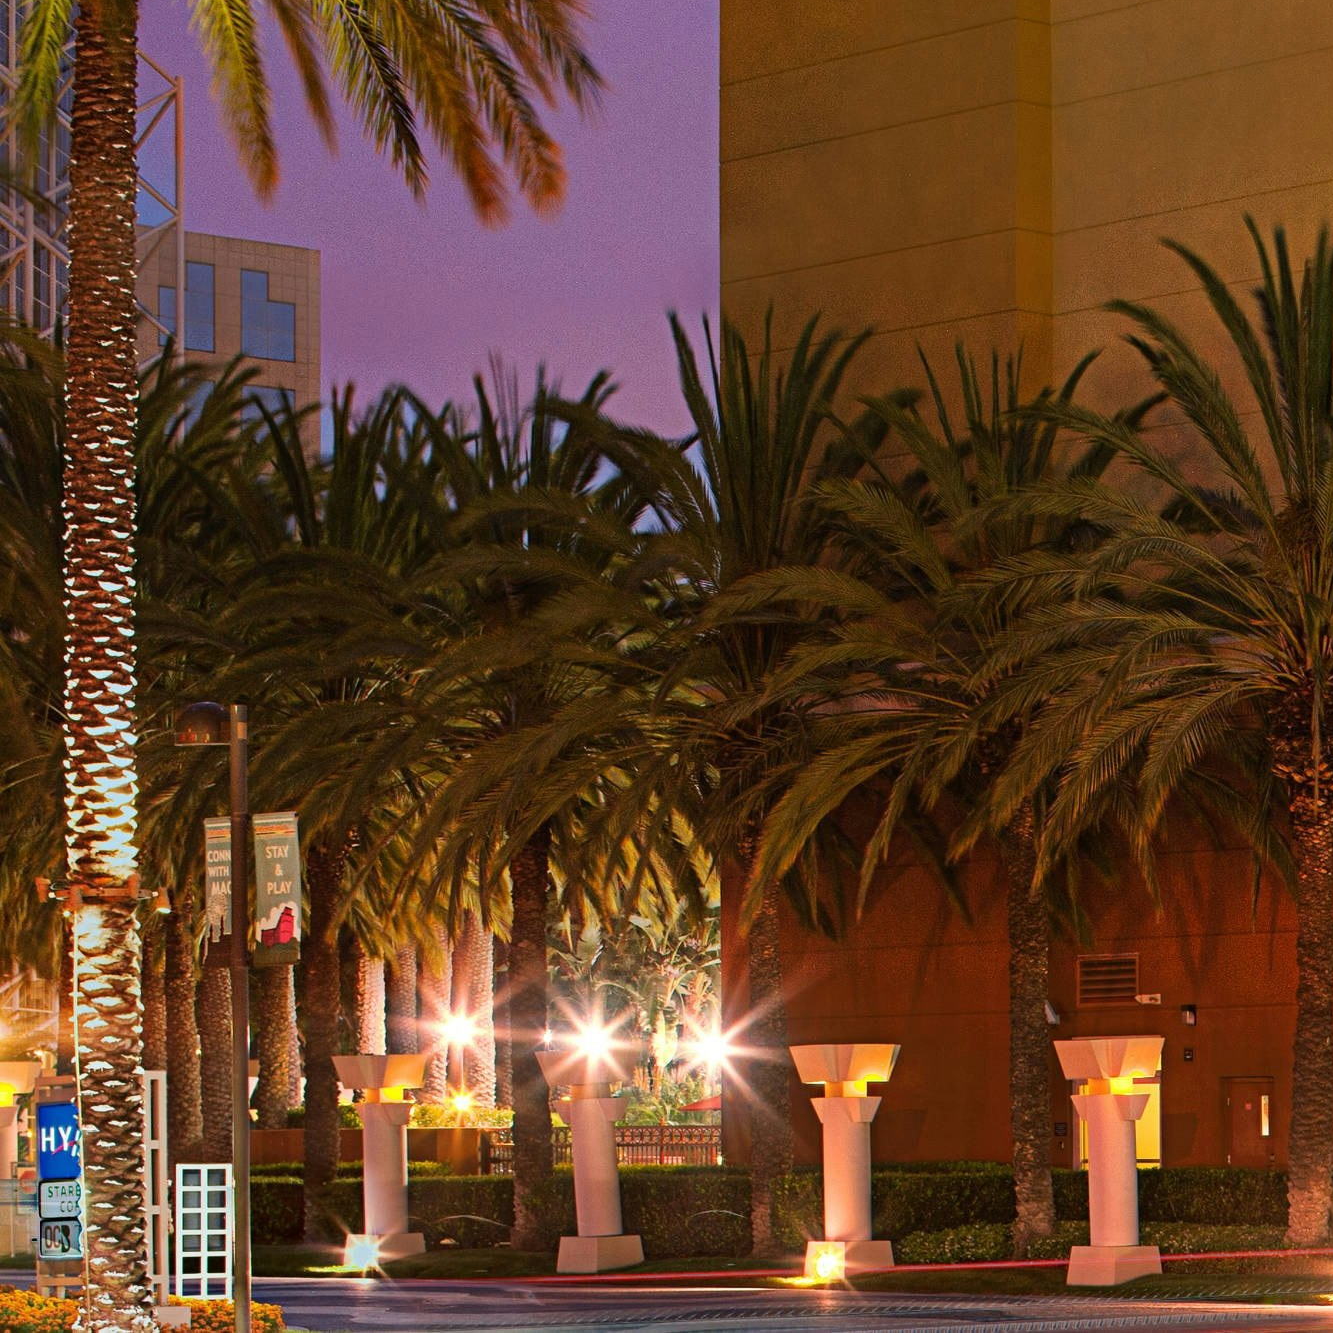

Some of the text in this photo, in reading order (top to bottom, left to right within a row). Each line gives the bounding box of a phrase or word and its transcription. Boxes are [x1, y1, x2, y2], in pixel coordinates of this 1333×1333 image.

[207, 849, 232, 863] CONN
[265, 845, 289, 859] STAY
[207, 865, 230, 878] WITH
[274, 864, 283, 877] &
[267, 881, 292, 895] PLAY
